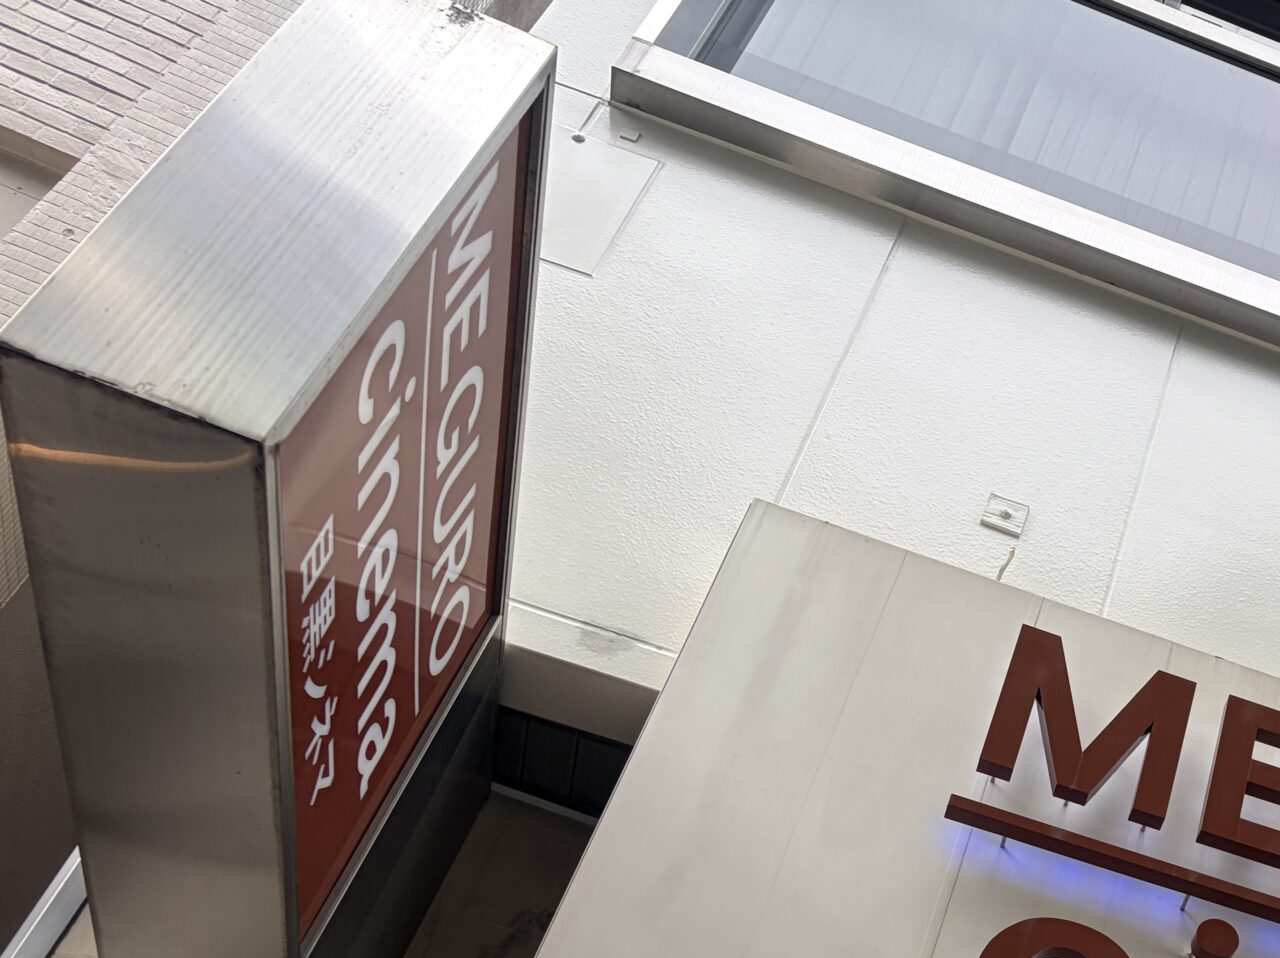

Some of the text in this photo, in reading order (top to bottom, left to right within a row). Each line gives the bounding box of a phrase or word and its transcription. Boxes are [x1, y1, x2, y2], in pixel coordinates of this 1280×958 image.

[300, 513, 338, 806] 目黒シネマ
[357, 319, 416, 801] cinema
[429, 159, 499, 678] MEGURO
